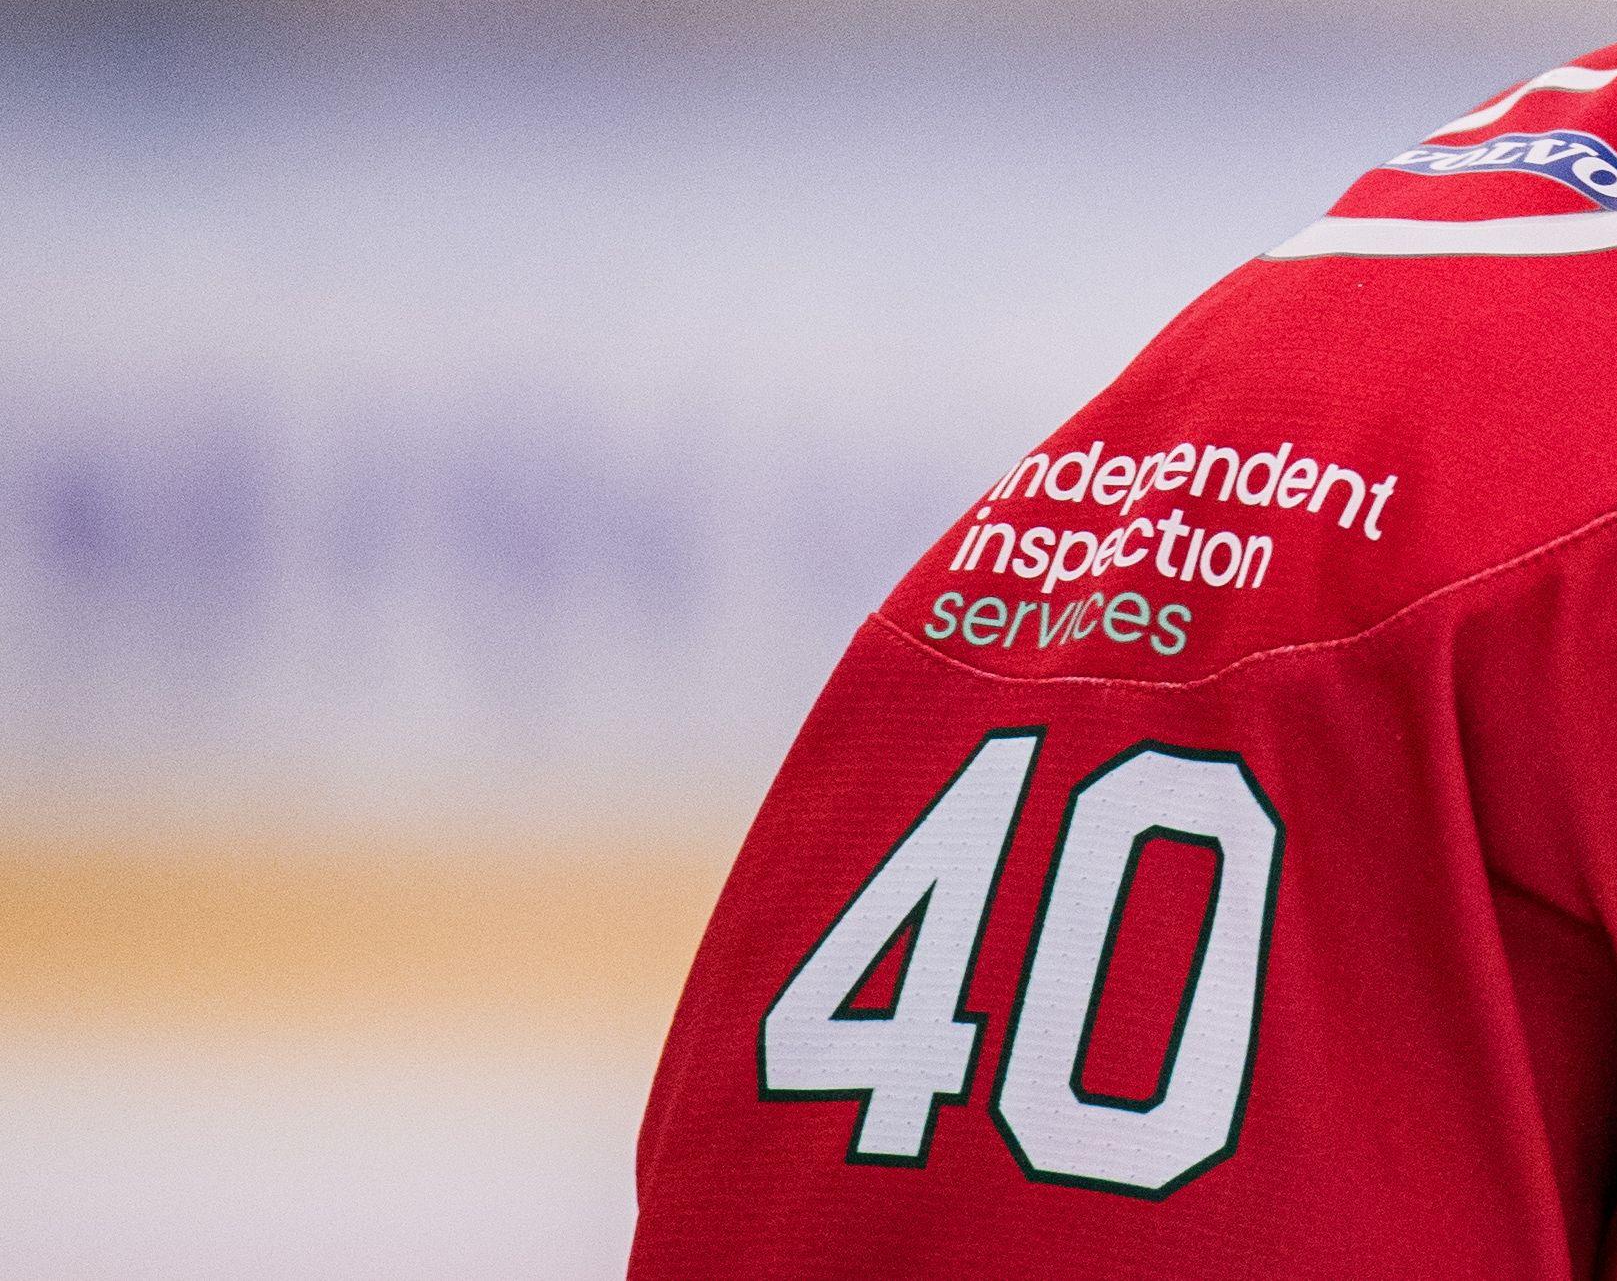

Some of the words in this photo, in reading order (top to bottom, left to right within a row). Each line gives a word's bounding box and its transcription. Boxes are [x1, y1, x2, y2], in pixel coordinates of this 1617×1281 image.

[987, 440, 1398, 542] independent
[950, 506, 1274, 594] inspection
[924, 591, 1192, 656] services
[757, 725, 1286, 1202] 40
